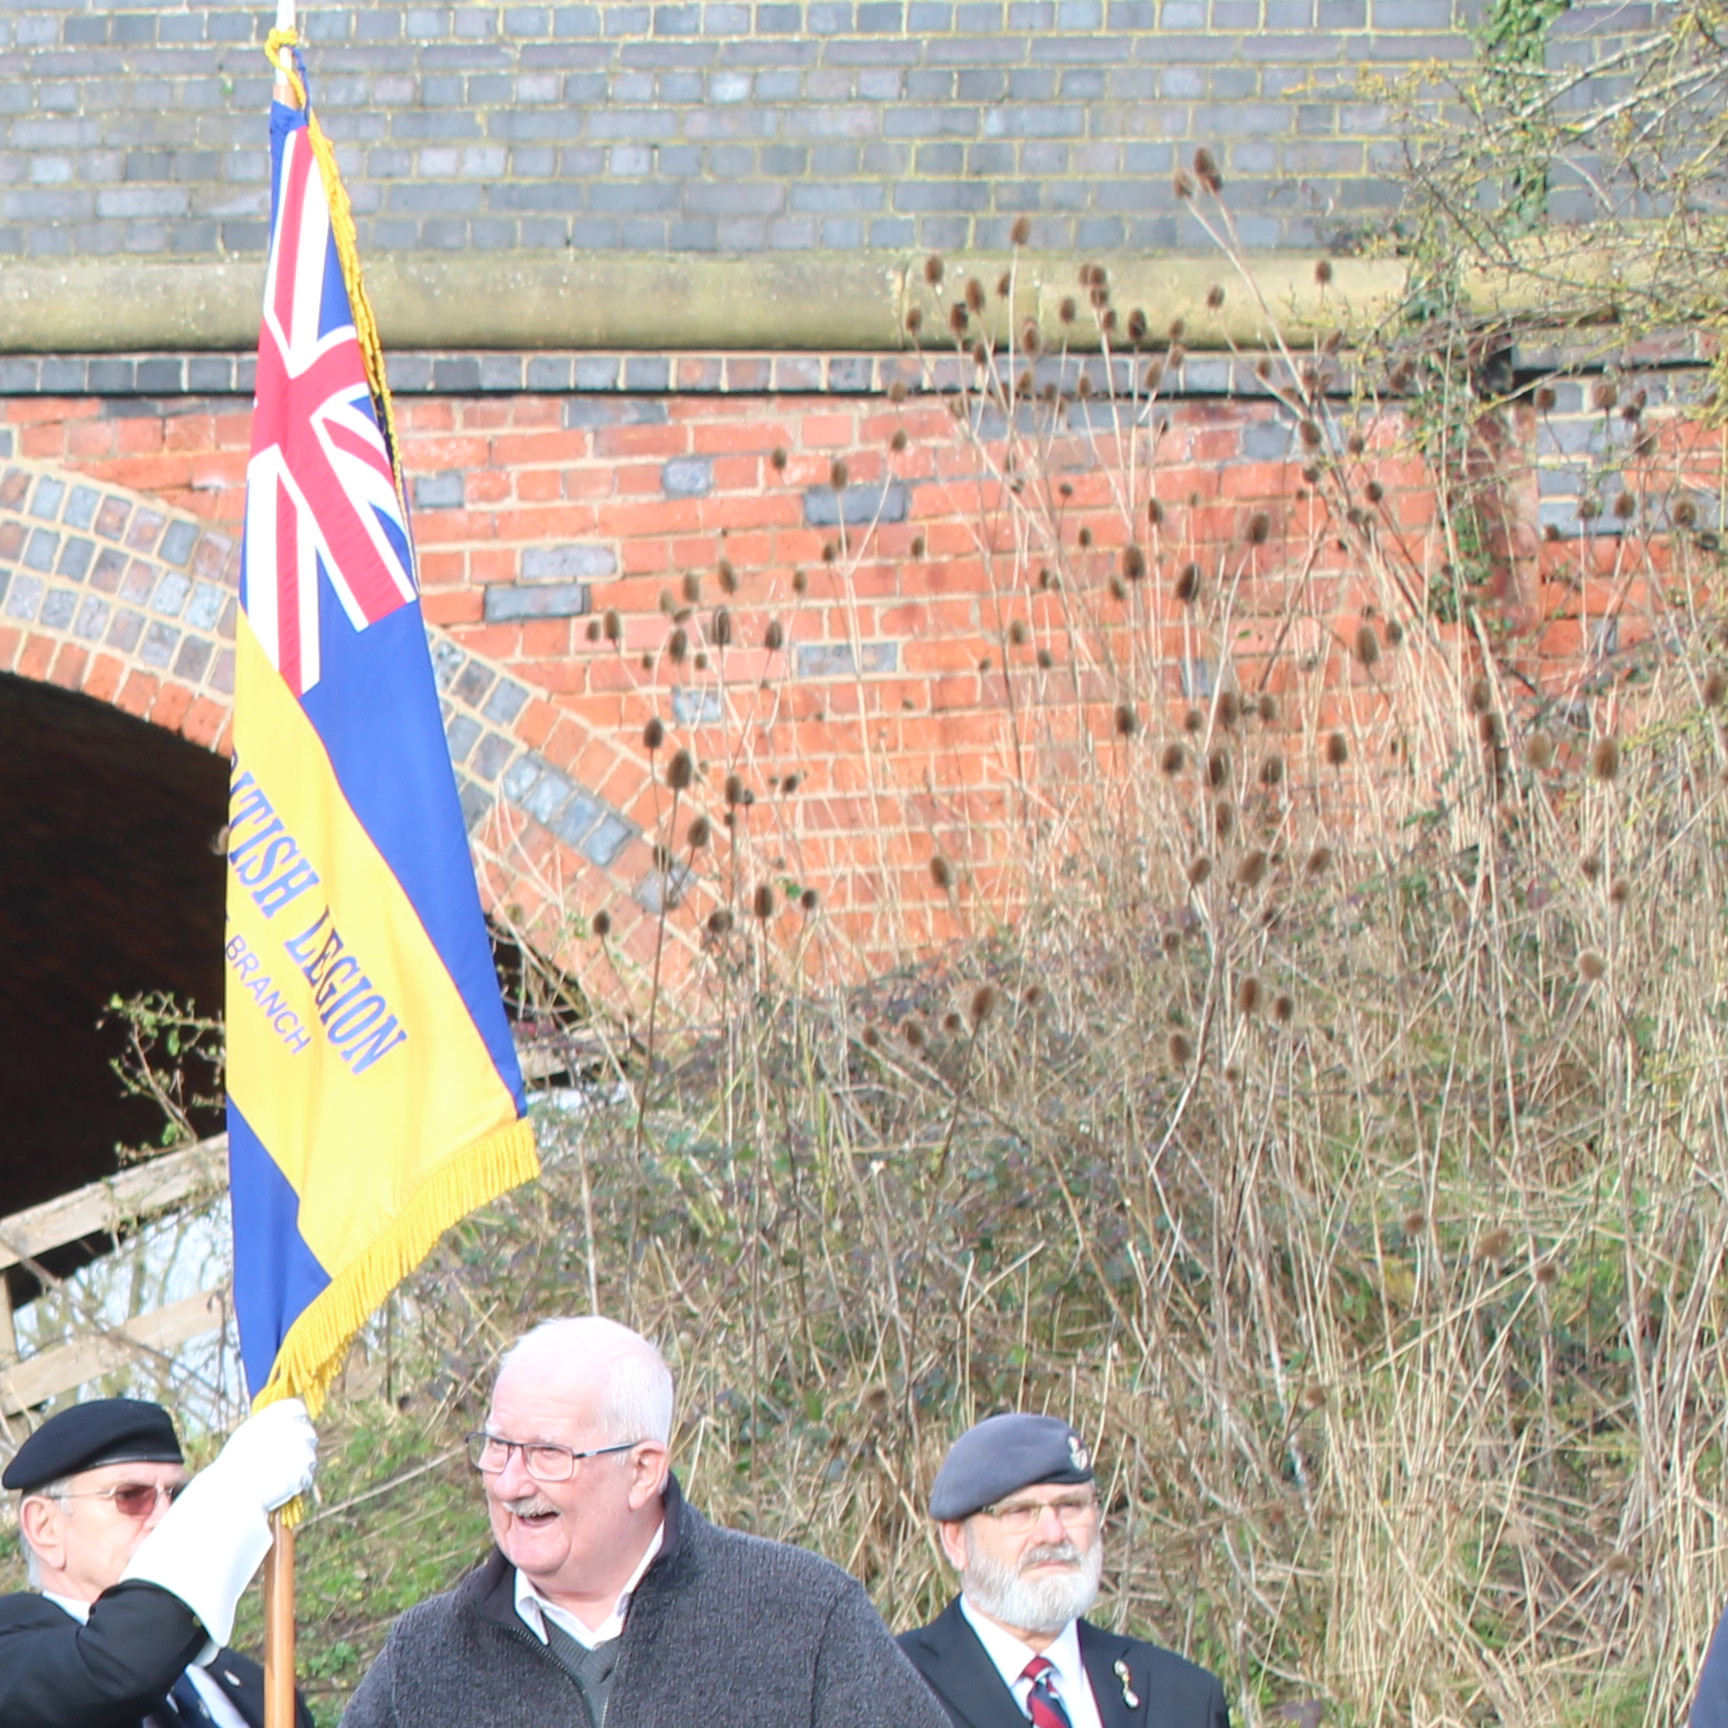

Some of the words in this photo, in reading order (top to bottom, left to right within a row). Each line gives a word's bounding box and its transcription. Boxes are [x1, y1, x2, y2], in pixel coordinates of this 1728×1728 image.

[225, 934, 312, 1056] BRANCH
[228, 749, 321, 919] ITISH
[284, 904, 408, 1076] LEGION
